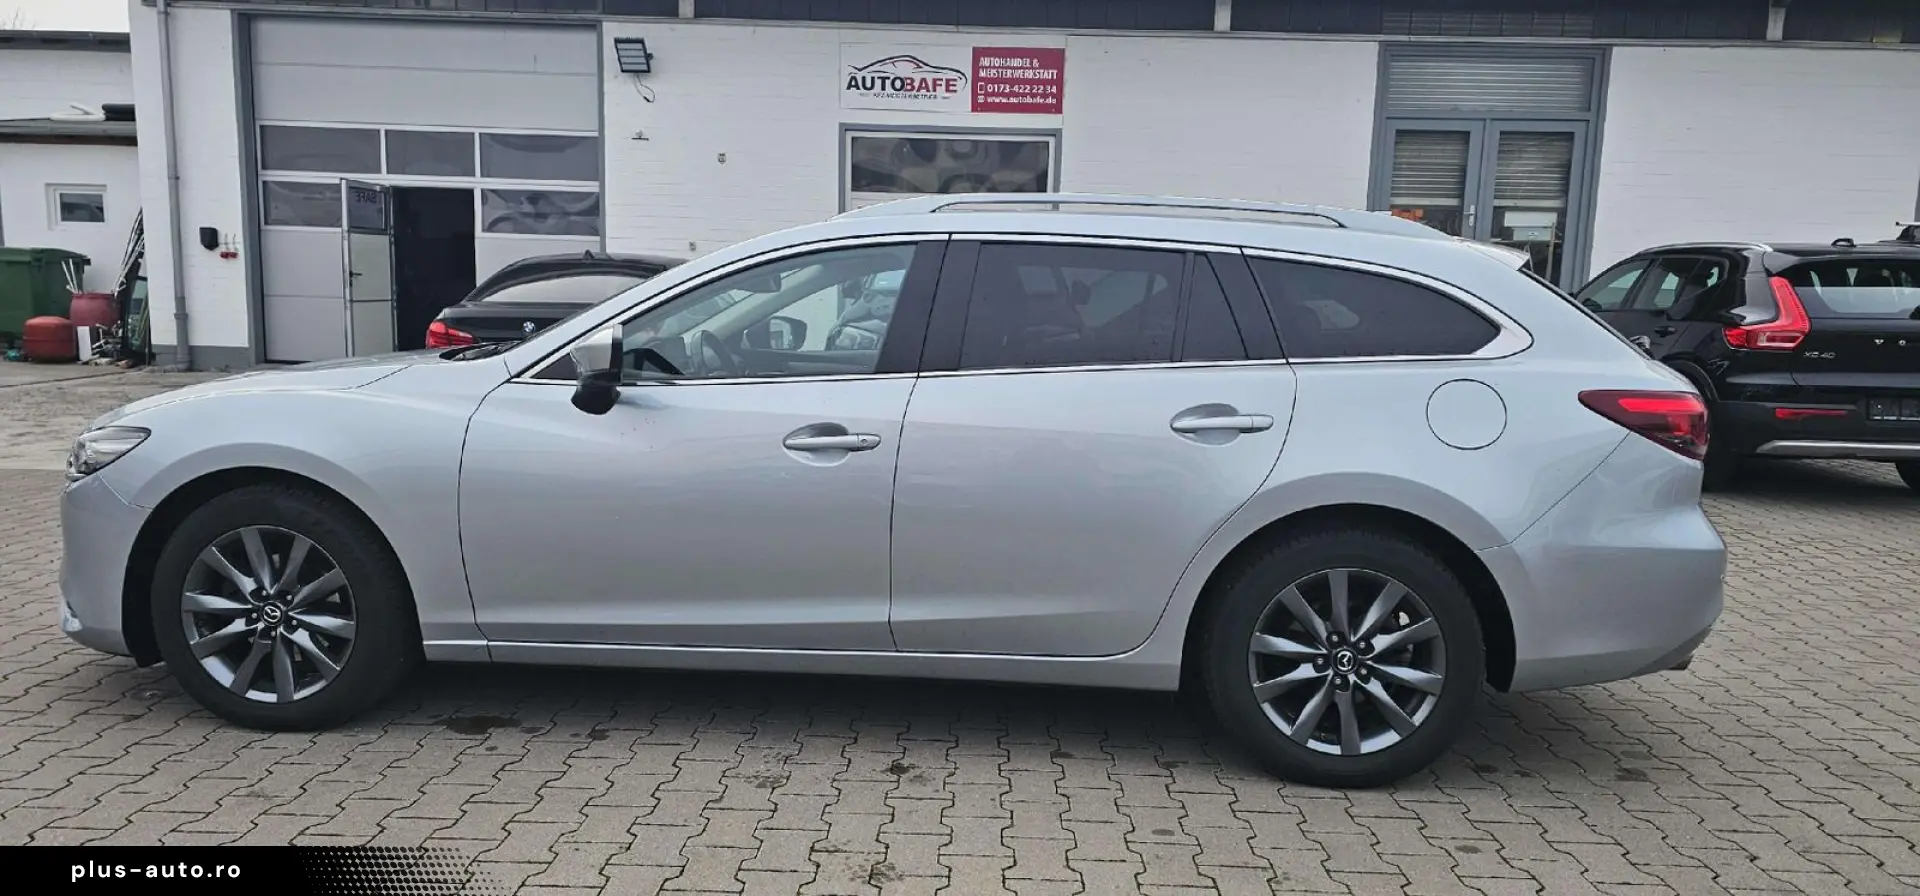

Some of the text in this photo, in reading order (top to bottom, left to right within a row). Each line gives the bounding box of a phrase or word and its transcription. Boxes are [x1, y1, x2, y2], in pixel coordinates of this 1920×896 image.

[979, 56, 1040, 68] AUTOHANDEL &
[978, 68, 1058, 80] MEISTERWERKSTATT
[845, 75, 958, 94] AUTOBAFE
[987, 84, 1057, 94] 0173-422 22 34
[986, 95, 1057, 104] www.autobafe.de
